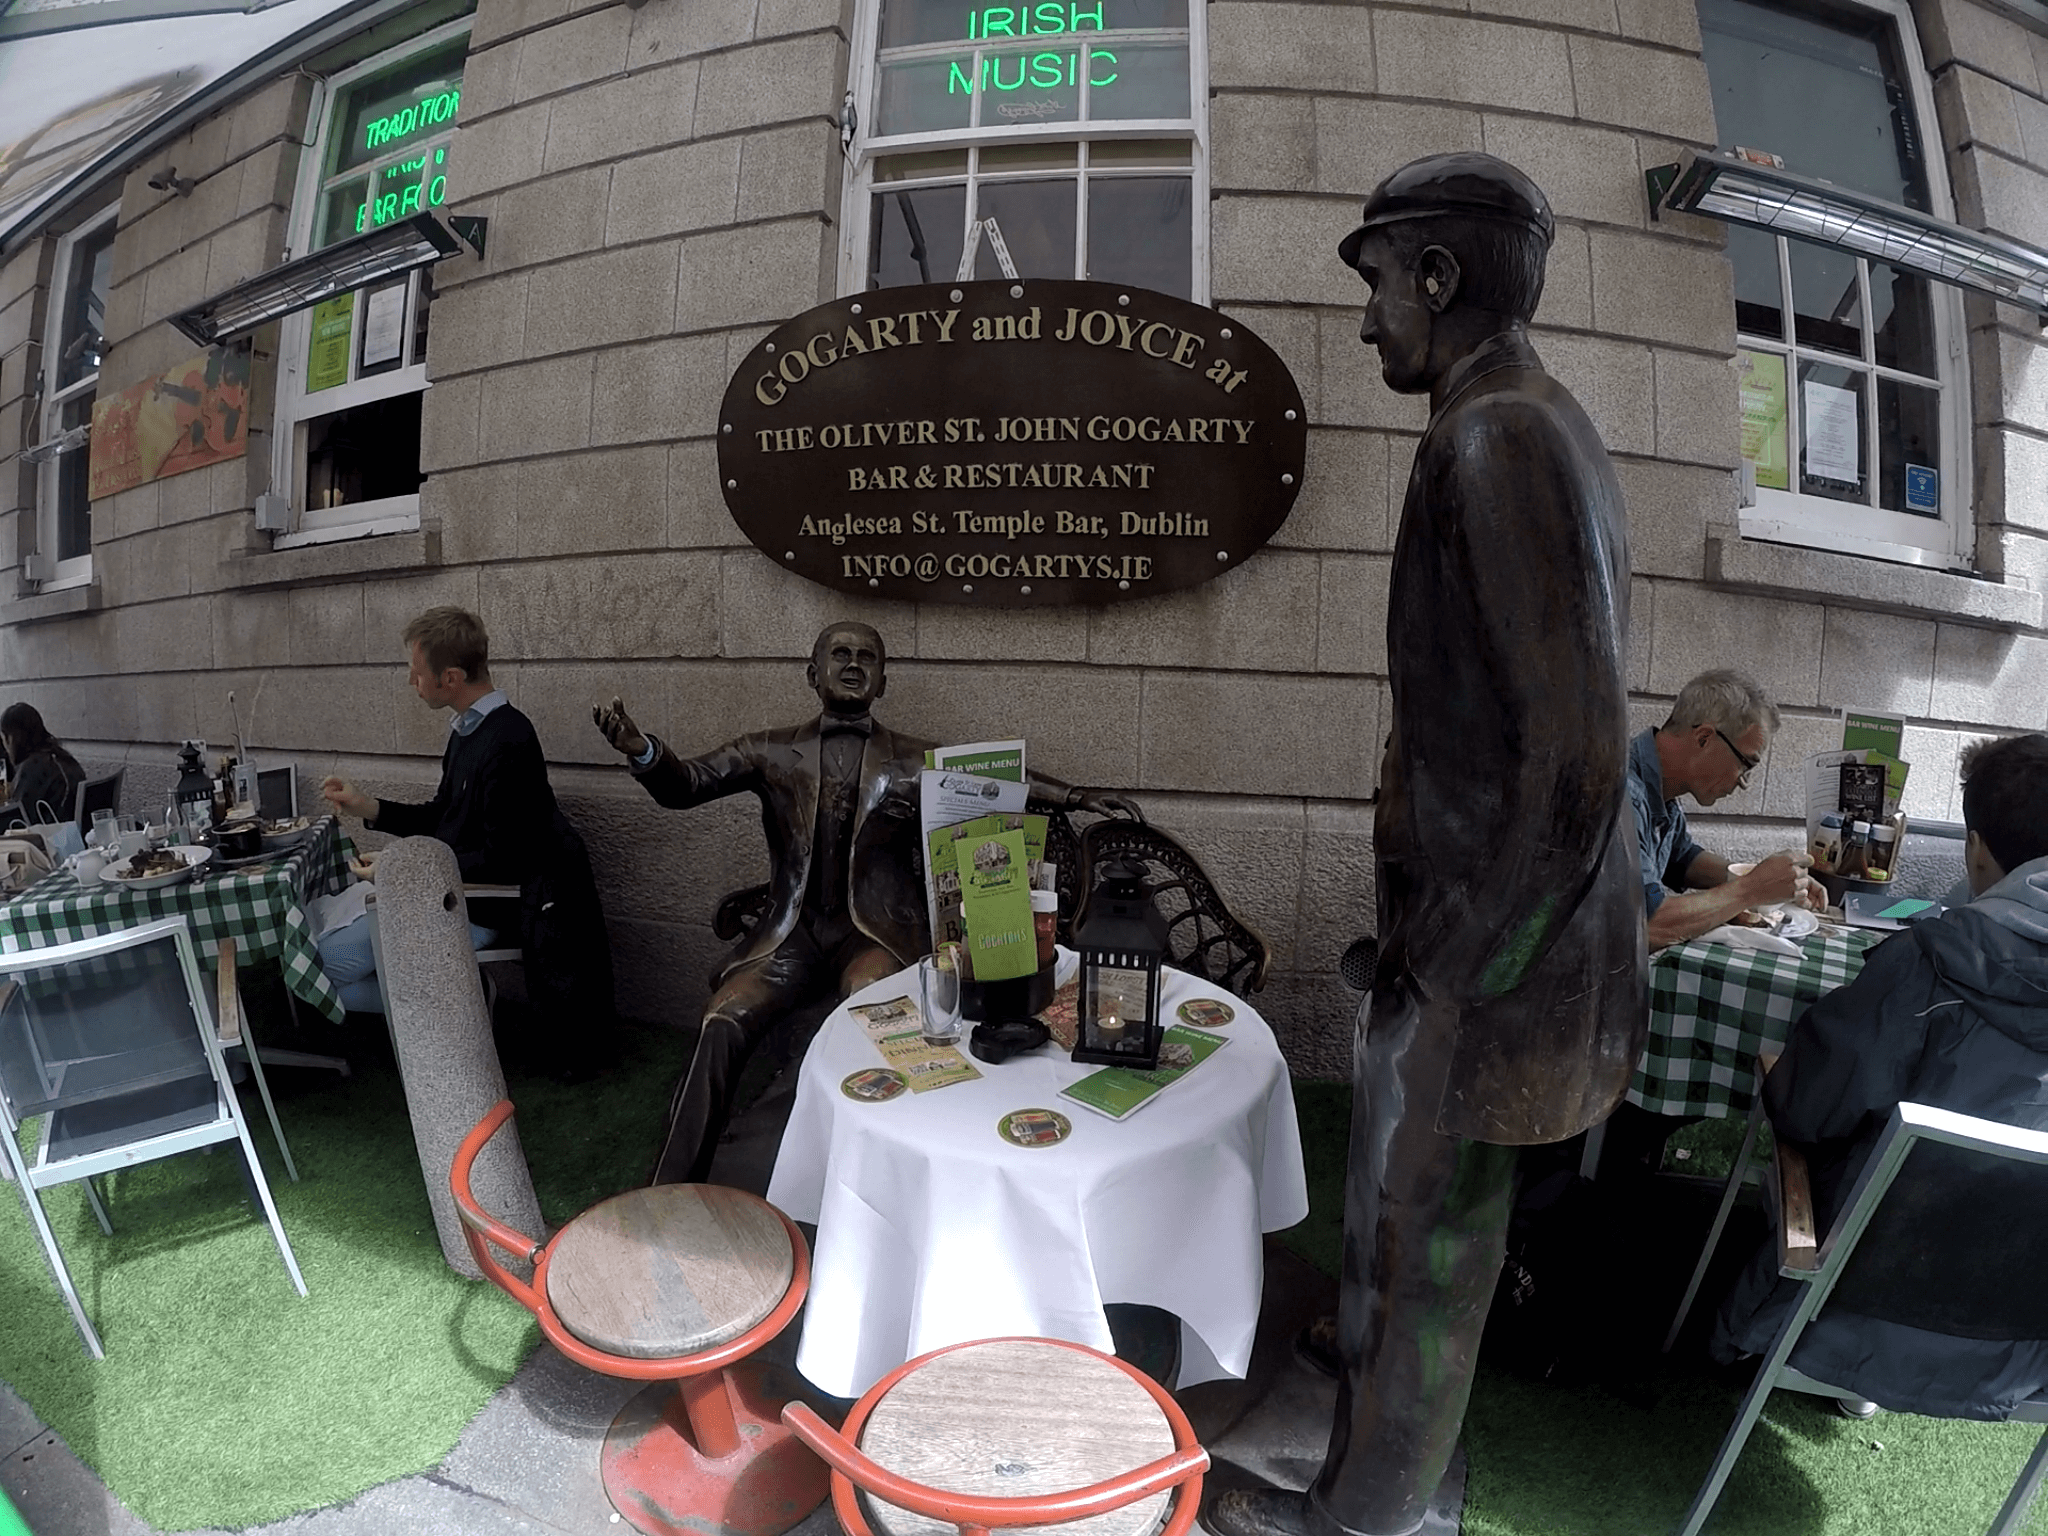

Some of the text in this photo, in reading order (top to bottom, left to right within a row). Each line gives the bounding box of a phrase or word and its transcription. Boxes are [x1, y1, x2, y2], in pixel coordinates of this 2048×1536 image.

[968, 1, 1104, 40] IRISH
[948, 50, 1118, 95] MUSIC
[755, 307, 1249, 406] GOGARTY and JOYCE at
[755, 415, 1255, 452] THE OLIVER ST. JOHN GOGARTY
[848, 463, 1155, 491] BAR & RESTAURANT
[798, 509, 1210, 546] Anglesea St. Temple Bar, Dublin
[965, 761, 990, 772] WINE
[991, 758, 1020, 769] MENU
